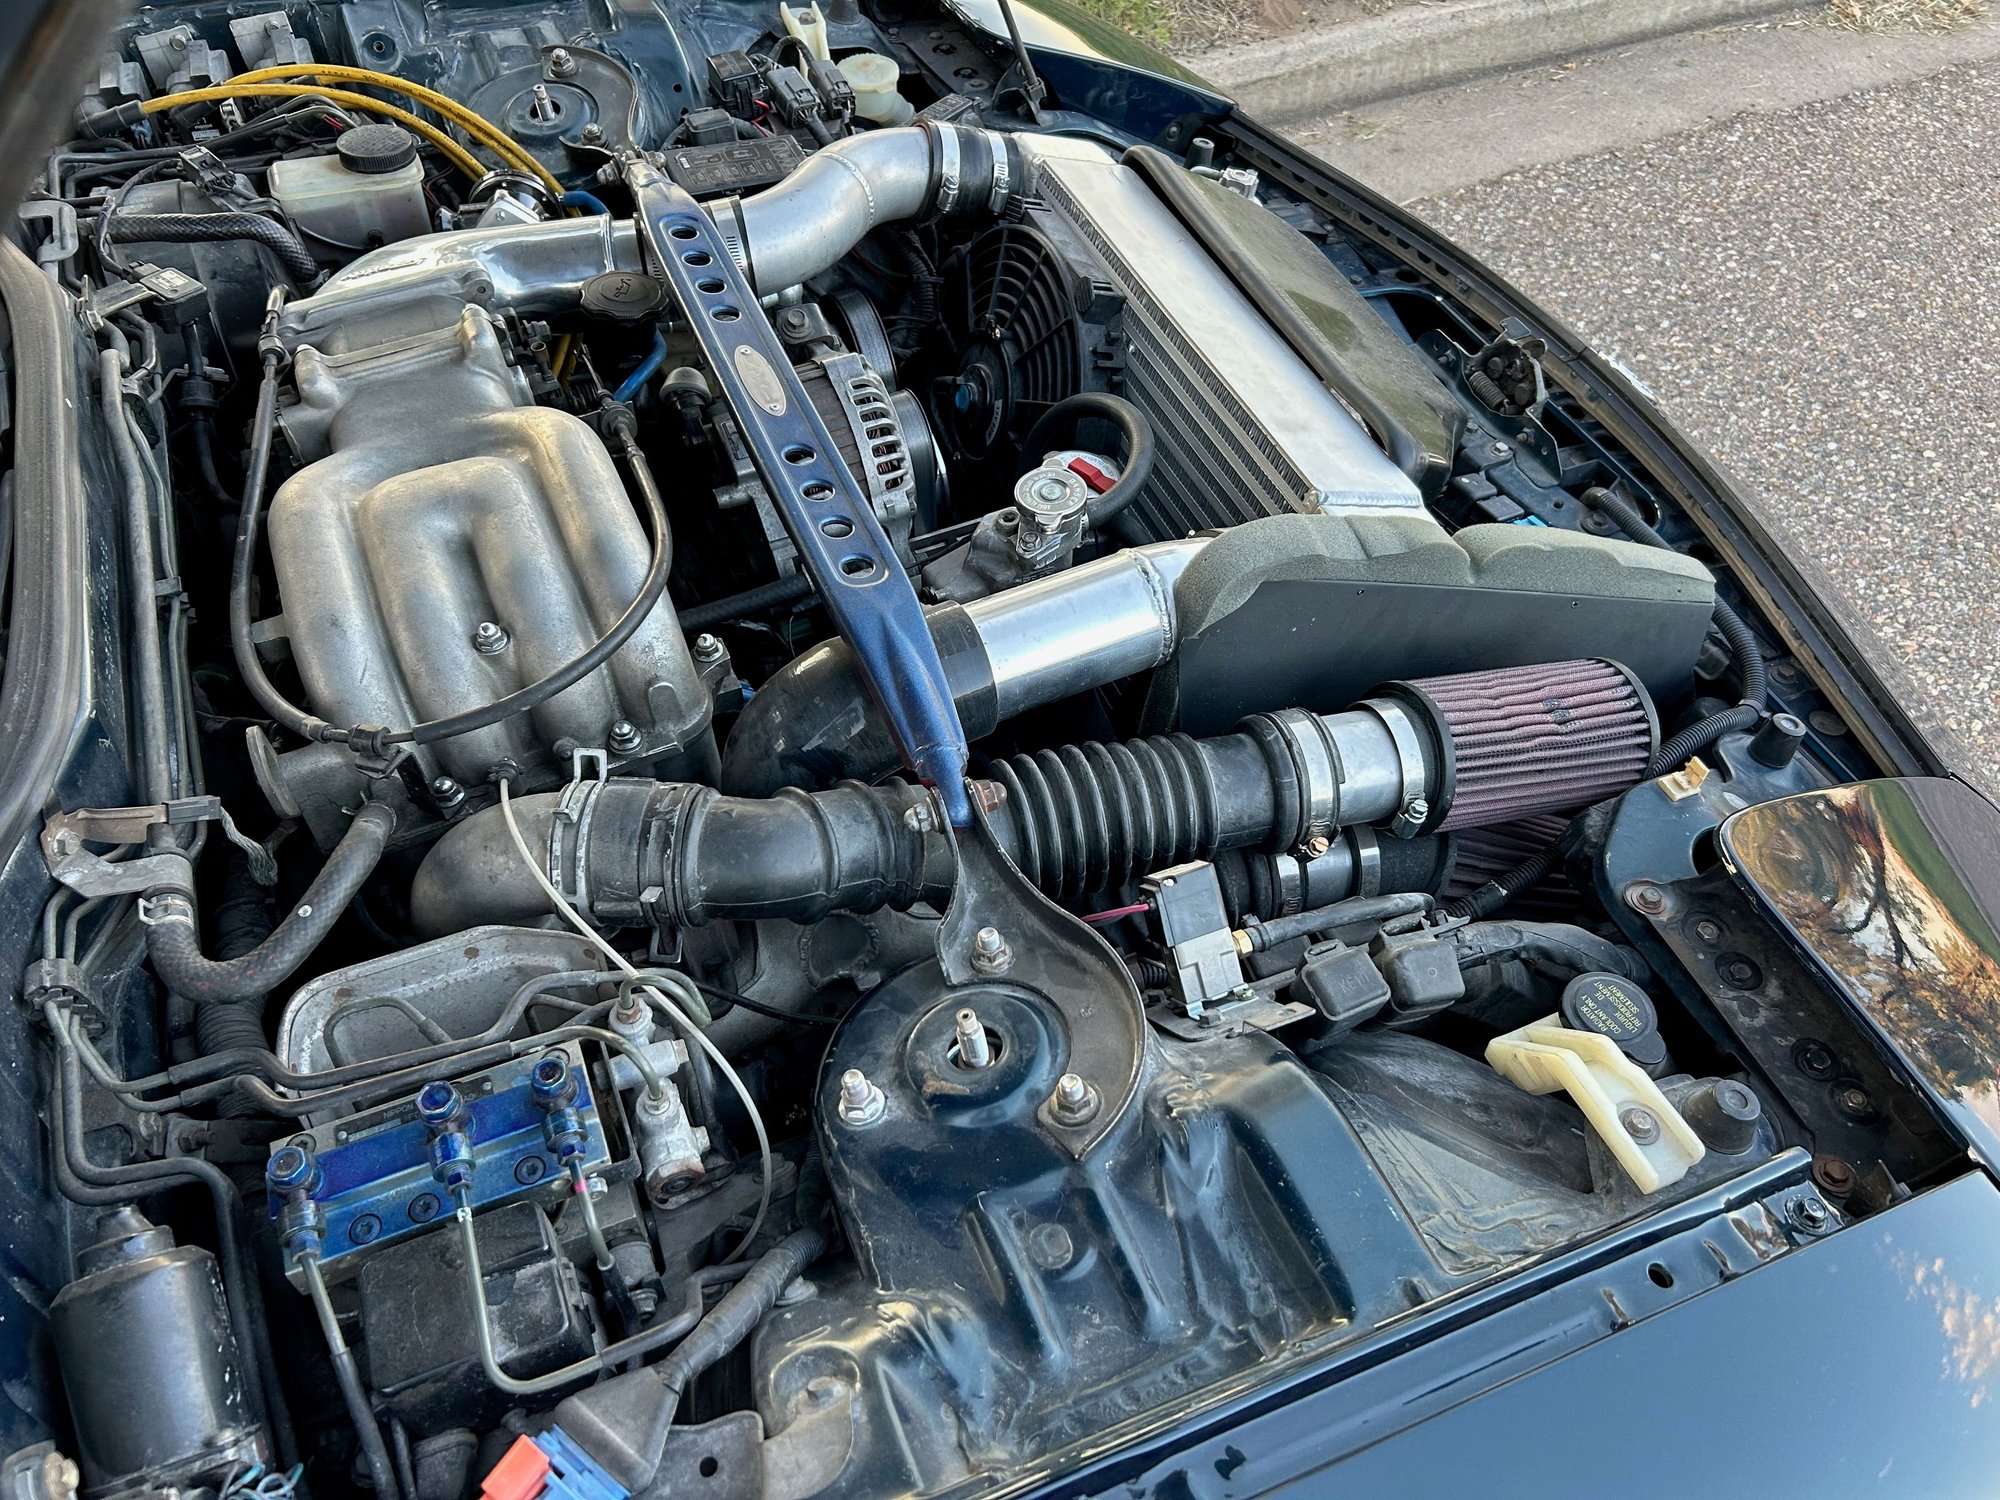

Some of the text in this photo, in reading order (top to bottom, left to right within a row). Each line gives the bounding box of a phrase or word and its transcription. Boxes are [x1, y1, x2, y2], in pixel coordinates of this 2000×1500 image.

[1068, 478, 1081, 505] DANGER
[1580, 993, 1621, 1034] COOLANT ONLY
[1593, 980, 1642, 1027] REFROIDISSEMENT
[1593, 990, 1637, 1033] LIQUIDE DE
[1607, 983, 1640, 1014] SEULEMENT
[1580, 1003, 1608, 1031] RADIATOR
[382, 1103, 414, 1119] NIPPON
